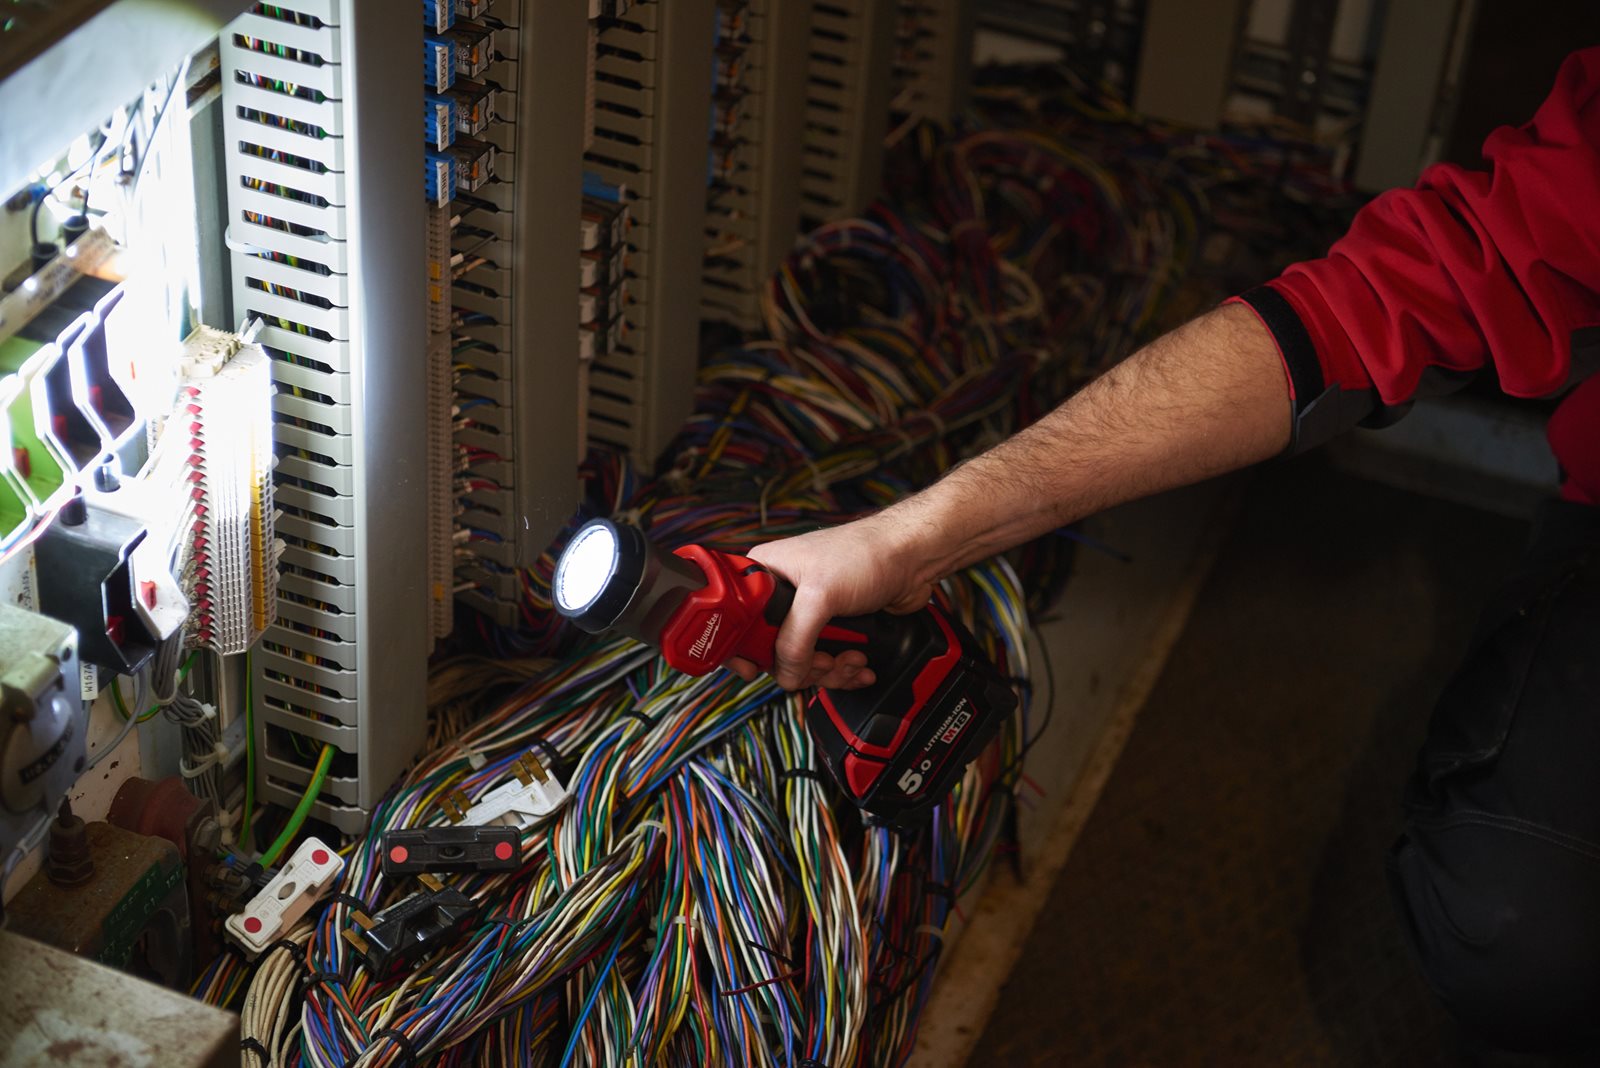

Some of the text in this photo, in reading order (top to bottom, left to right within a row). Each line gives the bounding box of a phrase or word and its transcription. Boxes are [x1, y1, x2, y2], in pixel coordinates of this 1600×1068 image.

[688, 613, 720, 659] Milwaukee
[942, 712, 970, 743] M18
[896, 759, 932, 796] 5.0
